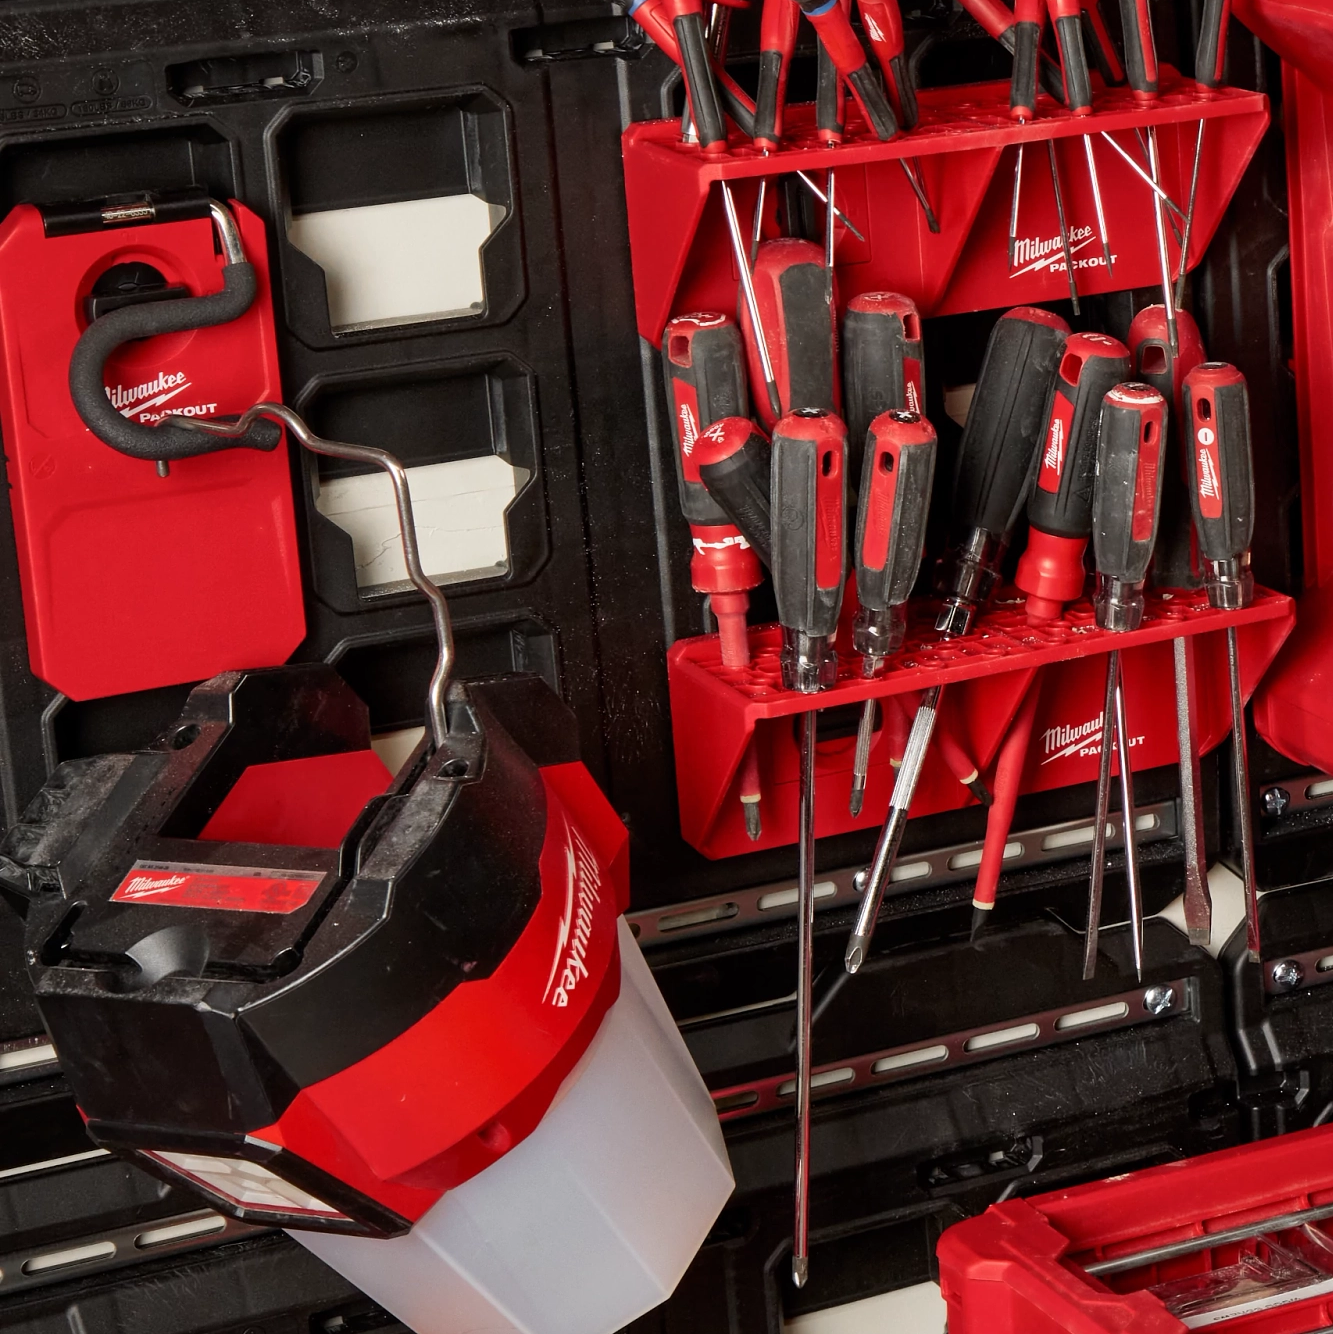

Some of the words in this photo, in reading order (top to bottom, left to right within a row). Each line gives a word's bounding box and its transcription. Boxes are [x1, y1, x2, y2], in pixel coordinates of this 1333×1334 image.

[683, 403, 699, 456] Milwaukee
[1045, 419, 1062, 470] Milwaukee
[1200, 449, 1214, 499] Milwaukee
[125, 874, 189, 894] Milwaukee
[551, 833, 602, 1007] Milwaukee
